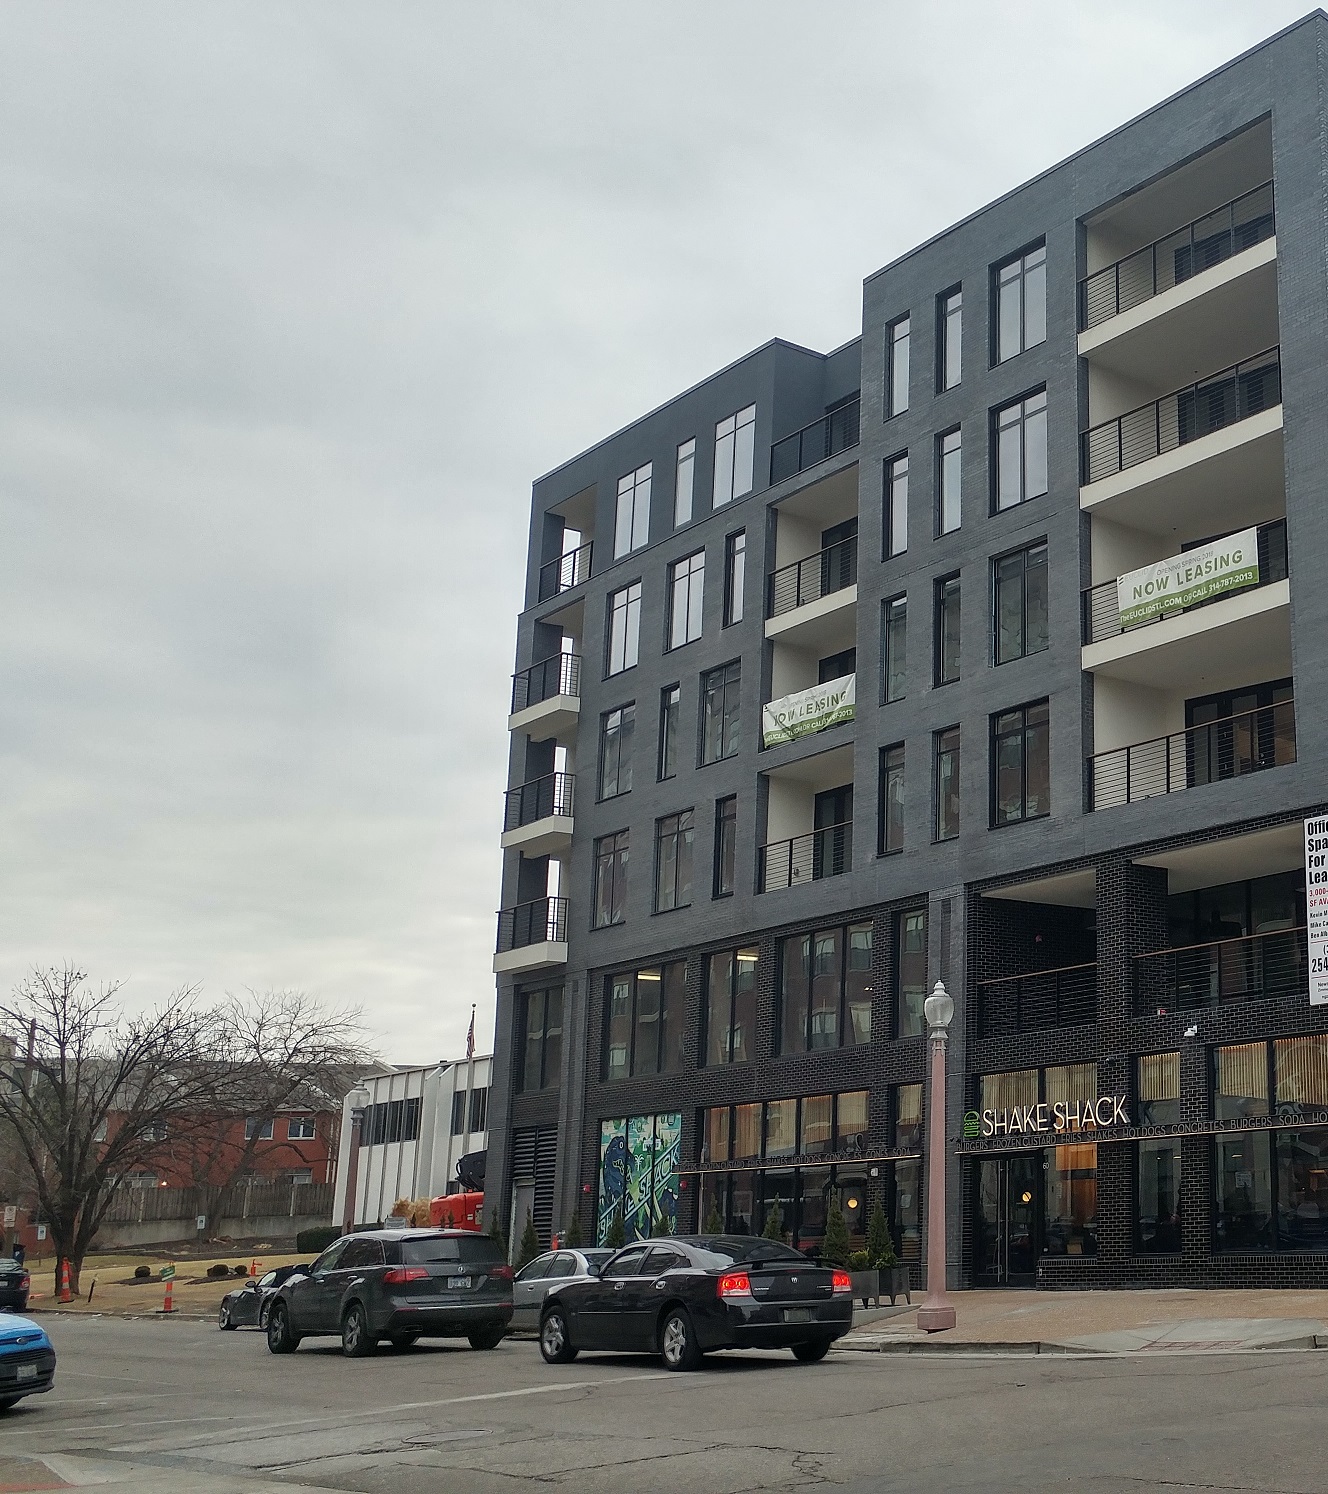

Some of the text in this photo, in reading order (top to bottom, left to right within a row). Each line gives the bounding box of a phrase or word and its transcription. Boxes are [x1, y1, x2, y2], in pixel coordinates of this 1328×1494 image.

[1133, 550, 1243, 600] NOW LEASING
[1192, 586, 1208, 598] CALL
[1208, 571, 1253, 593] 314-787-2013
[799, 690, 847, 717] LEASING
[1308, 854, 1326, 869] For
[1309, 899, 1318, 907] SF
[1309, 911, 1323, 919] Kevin
[982, 1094, 1129, 1137] SHAKE SHACK
[992, 1139, 1021, 1149] FROZEN
[1022, 1135, 1057, 1147] CUSTARD
[1061, 1132, 1082, 1143] FRIES
[1087, 1129, 1118, 1141] SHAKES
[1171, 1120, 1225, 1134] CONCRETES
[1230, 1116, 1273, 1129] BURGERS
[1280, 1114, 1305, 1126] SODA
